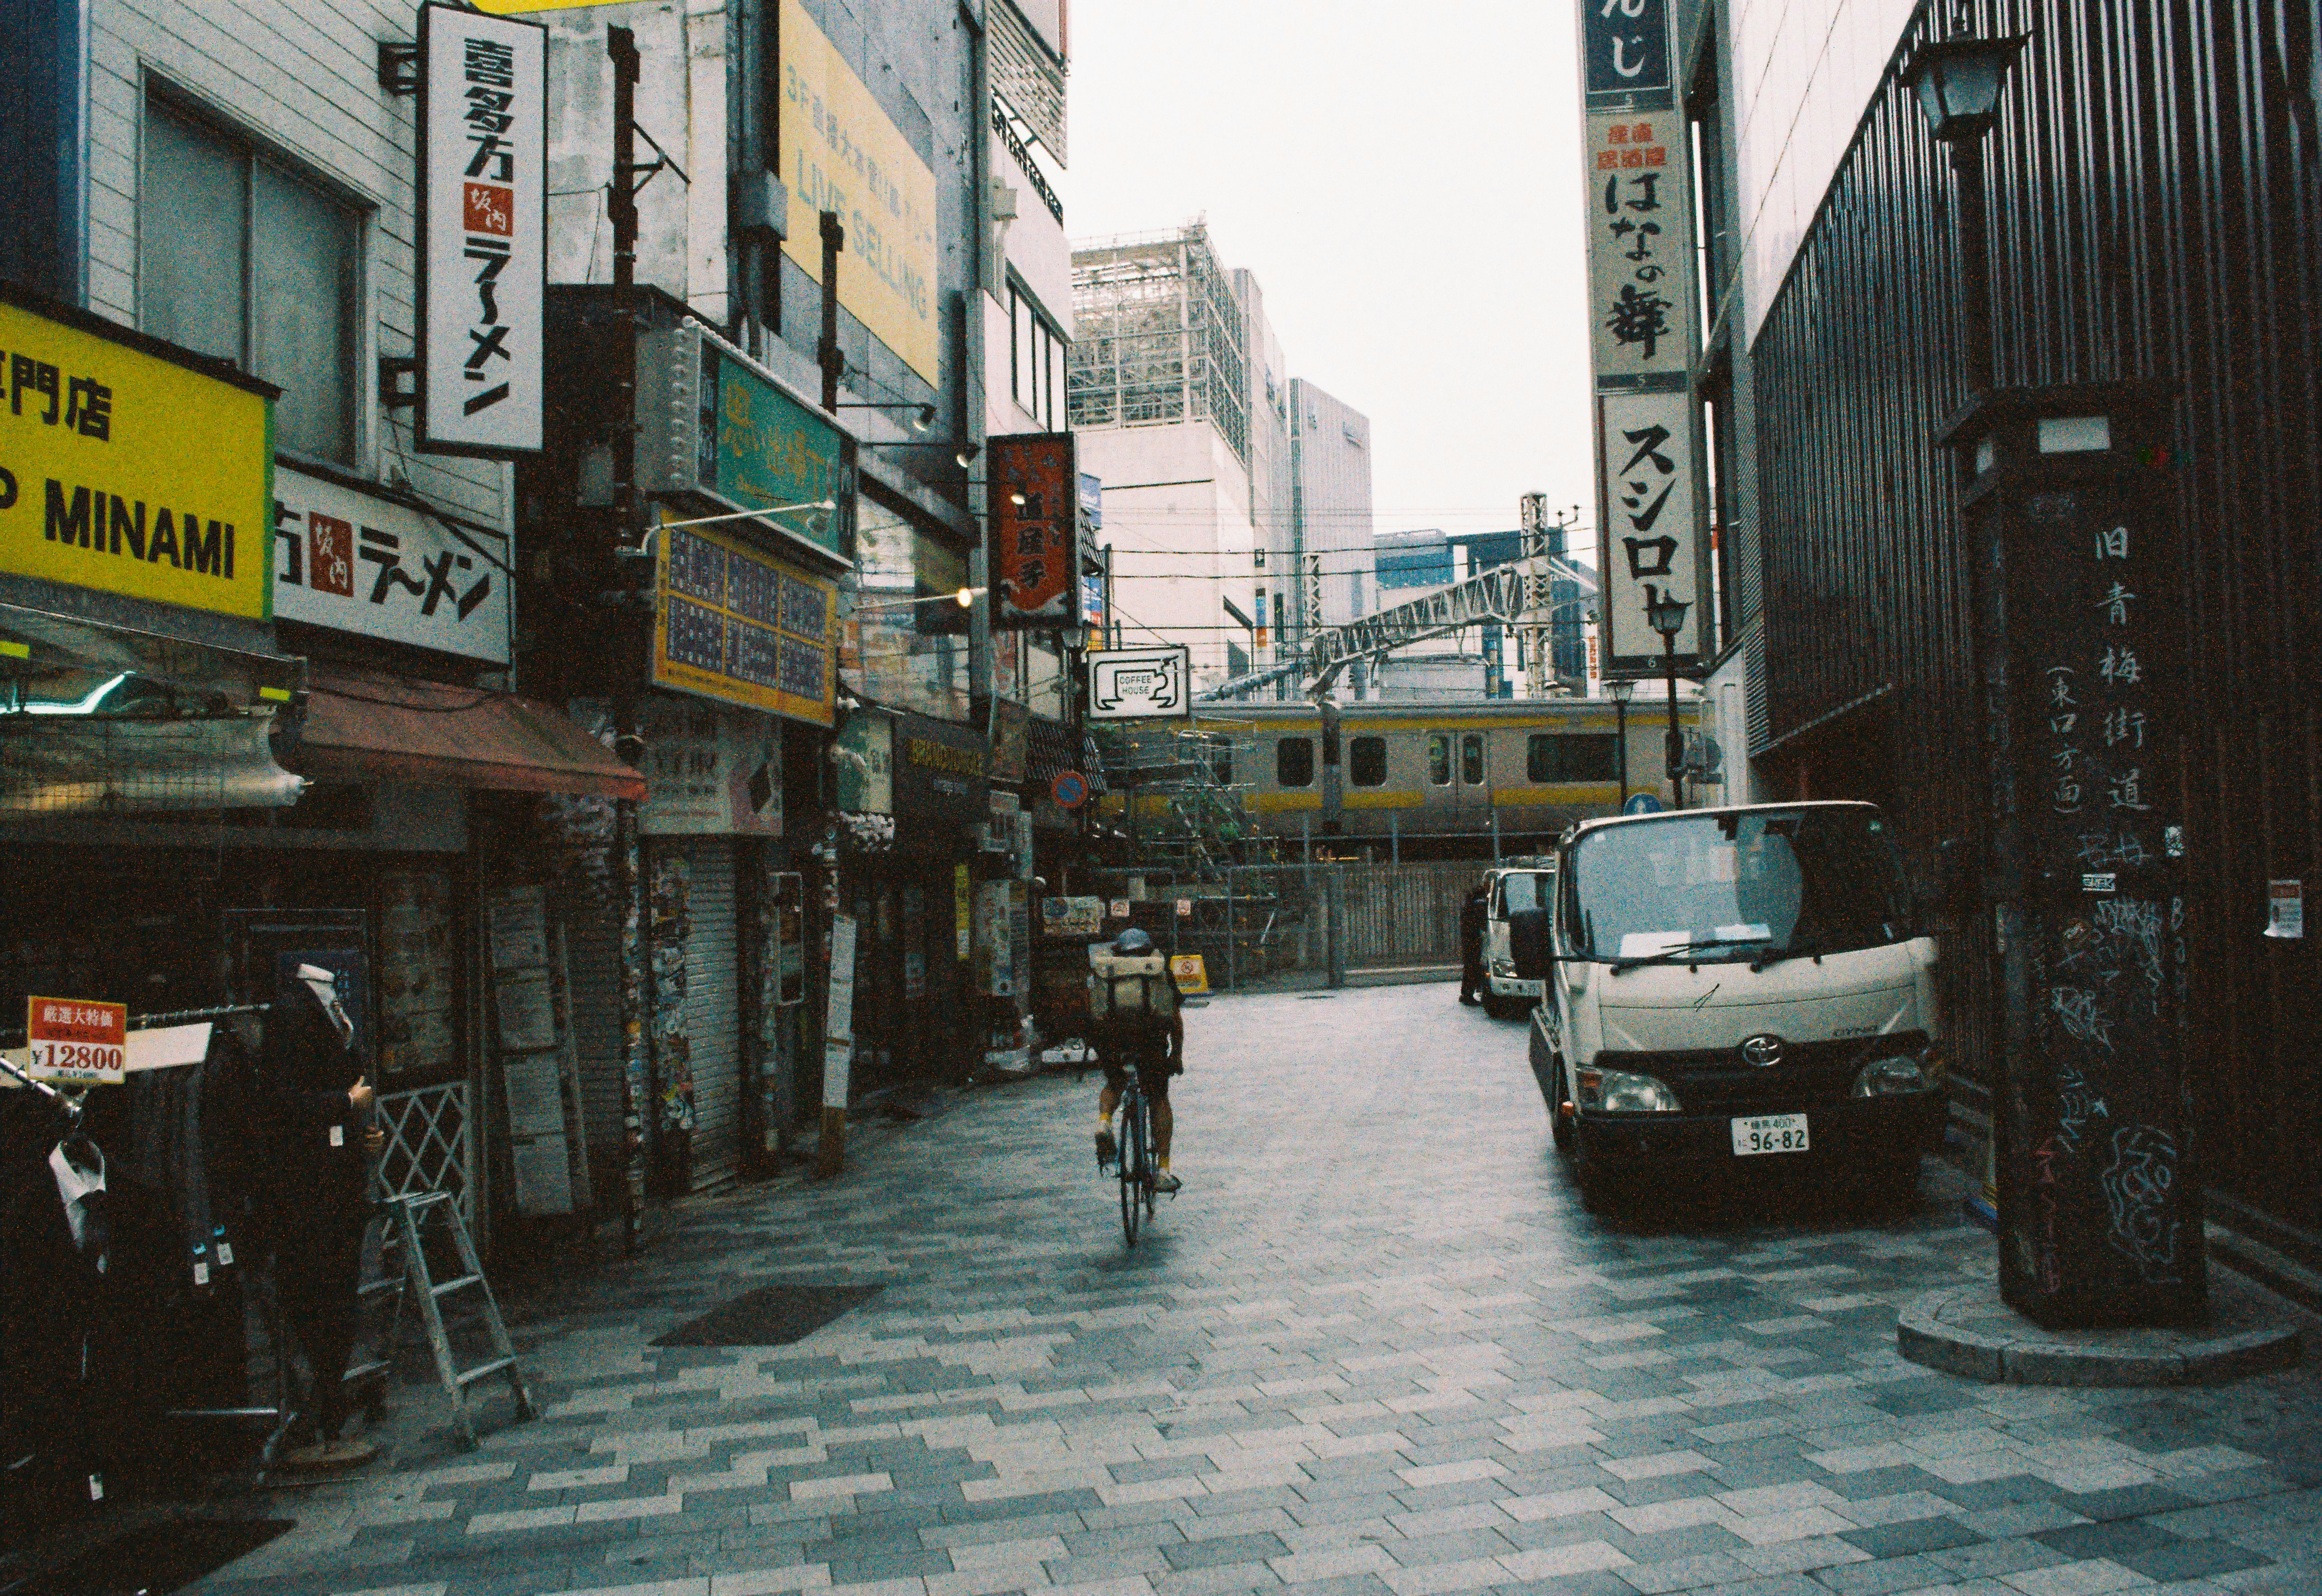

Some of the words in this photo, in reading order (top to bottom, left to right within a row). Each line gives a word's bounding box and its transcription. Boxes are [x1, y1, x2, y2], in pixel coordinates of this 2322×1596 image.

[0, 349, 112, 442] 門店
[45, 478, 235, 581] MINAMI
[1620, 424, 1678, 627] スシロー
[1119, 675, 1152, 685] COFFEE
[1122, 686, 1150, 695] HOUSE
[2095, 526, 2151, 810] 旧青梅街道
[1750, 1130, 1806, 1151] 96-82
